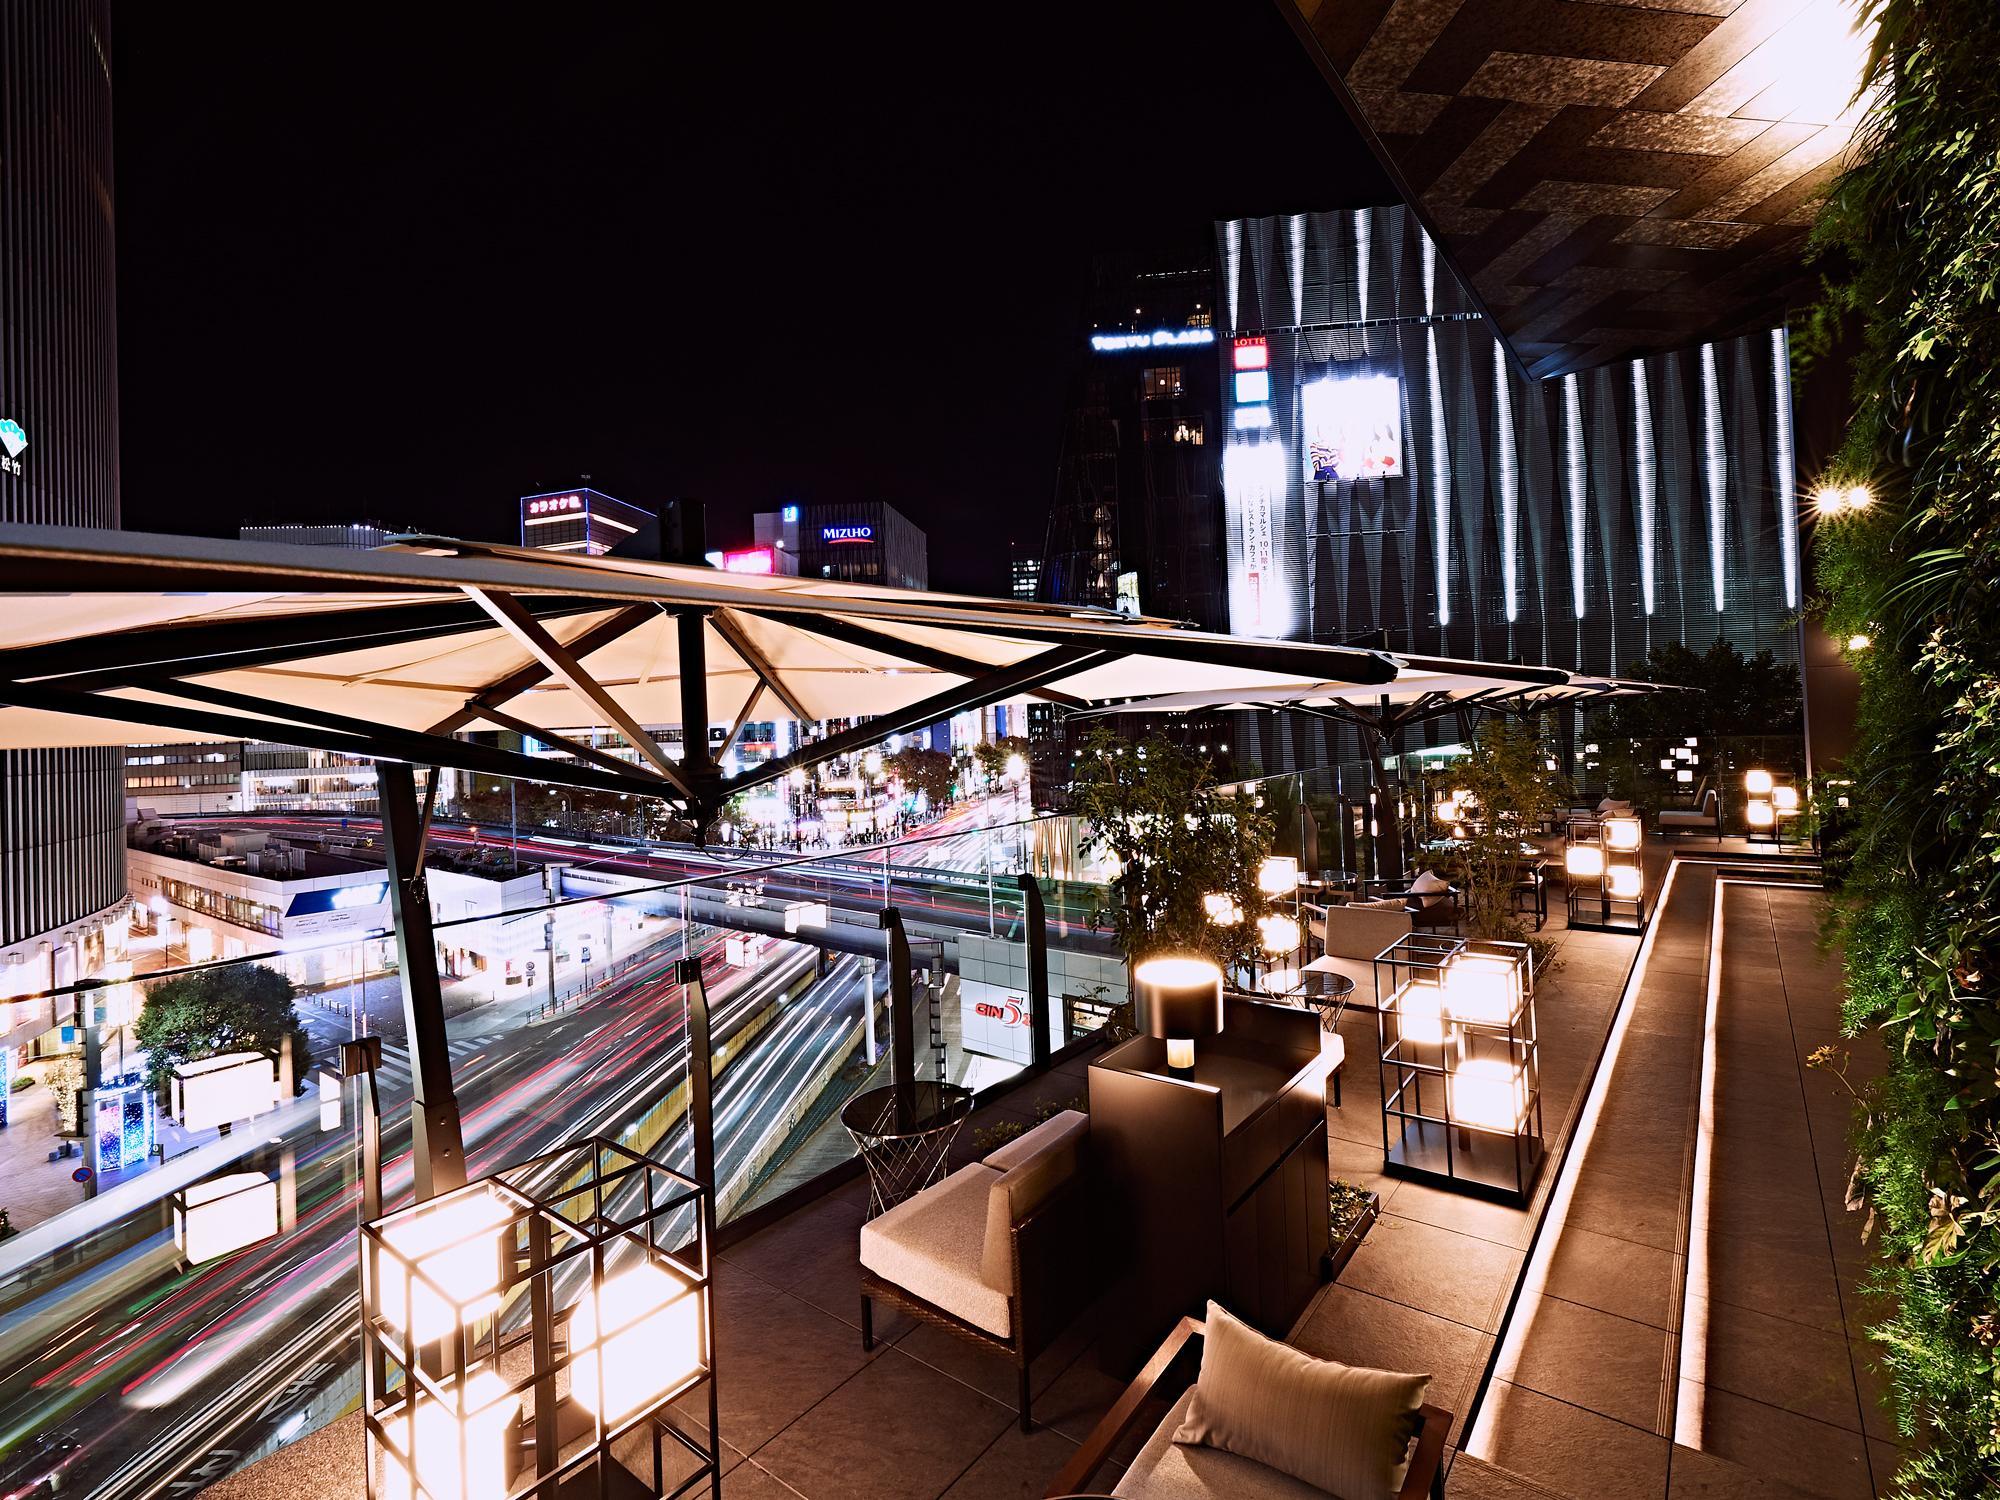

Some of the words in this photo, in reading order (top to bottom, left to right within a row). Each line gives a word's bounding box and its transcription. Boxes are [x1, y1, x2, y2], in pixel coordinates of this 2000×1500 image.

[1235, 337, 1266, 347] LOTTE
[1, 455, 21, 476] 松竹
[823, 527, 871, 539] MIZUHO
